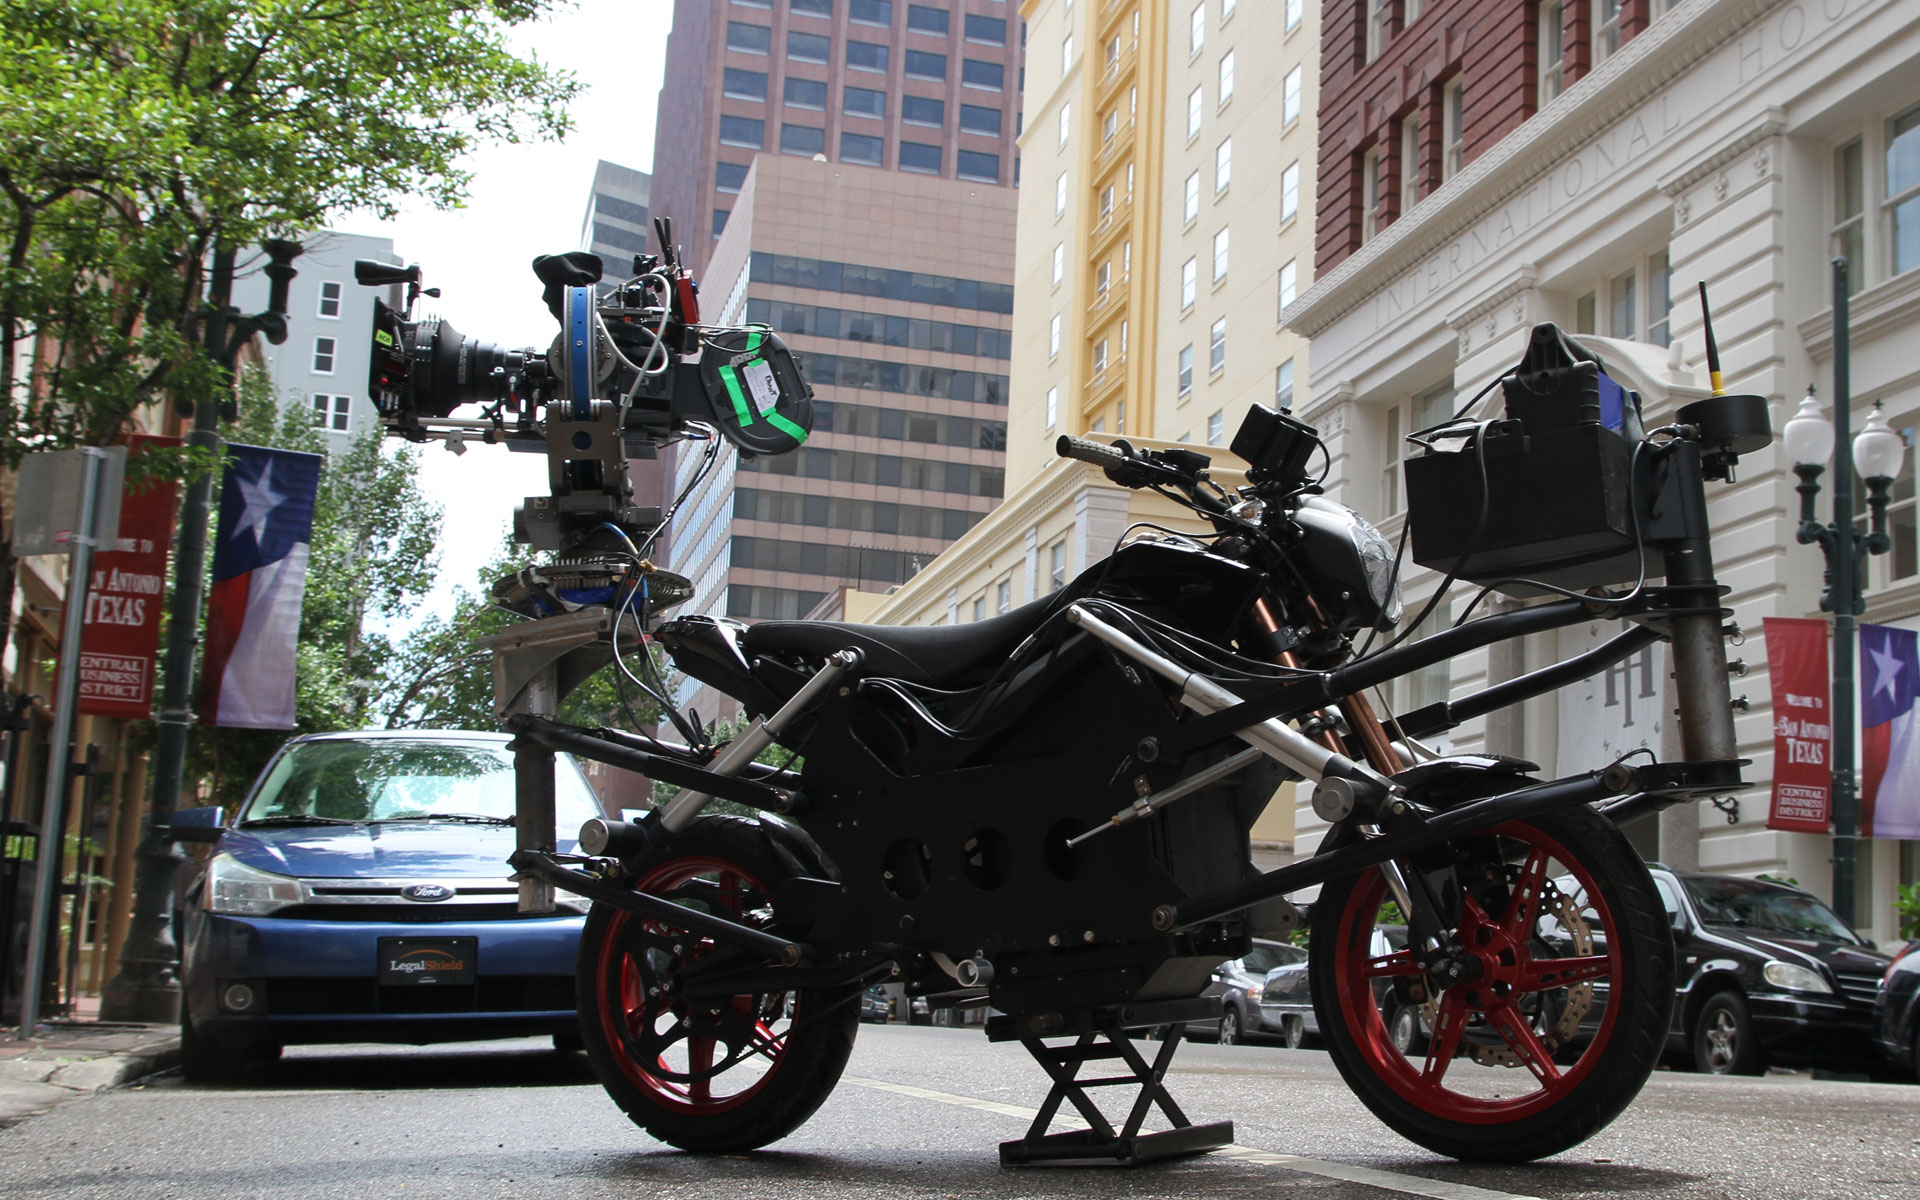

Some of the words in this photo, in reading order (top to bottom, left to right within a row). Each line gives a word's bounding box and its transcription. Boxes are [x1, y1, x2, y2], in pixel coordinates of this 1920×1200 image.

[1375, 95, 1681, 330] INTERNATIONAL
[106, 567, 161, 595] ANTONIO
[84, 592, 146, 626] TEXAS
[80, 656, 142, 671] ENTRAL
[80, 668, 140, 685] USINESS
[1786, 738, 1824, 765] TEXAS
[1780, 787, 1824, 799] CENTRAL
[1780, 796, 1823, 808] BUSINESS
[1779, 806, 1822, 818] DISTRICT
[413, 885, 443, 897] Ford
[390, 960, 463, 973] LegalShield
